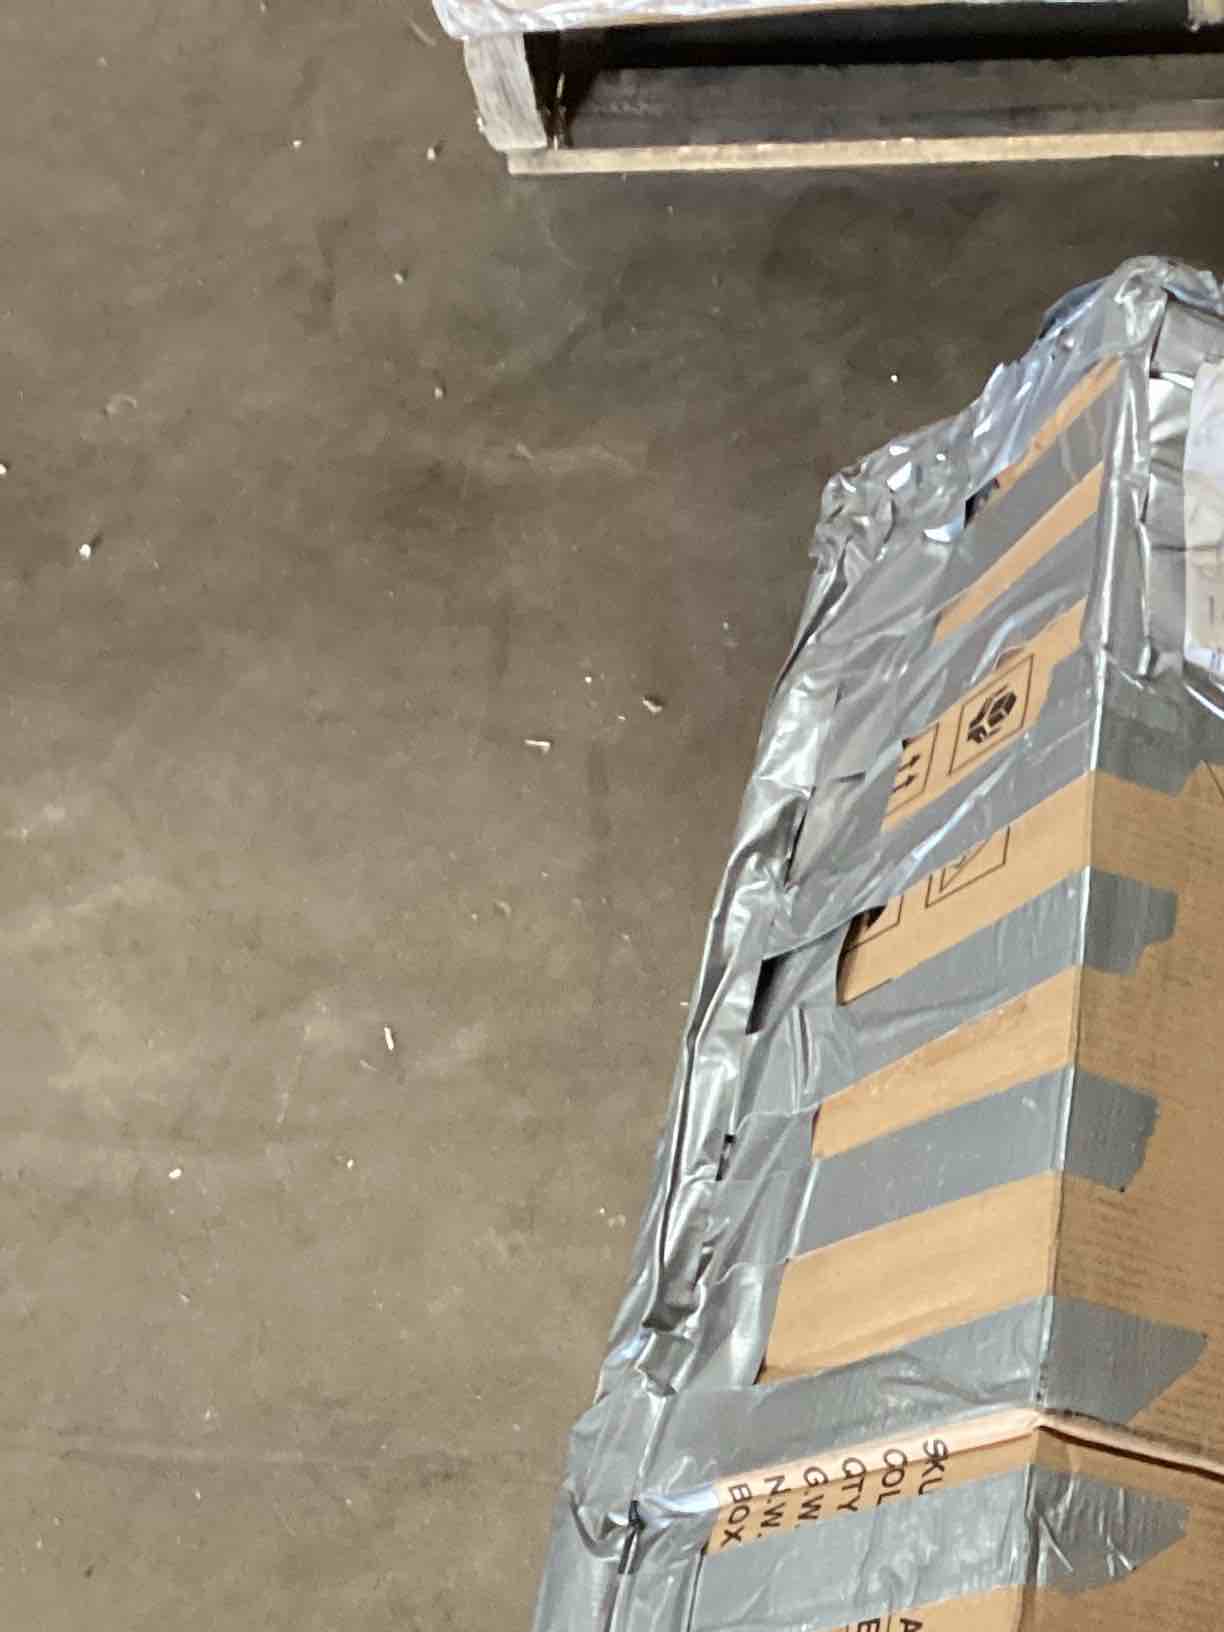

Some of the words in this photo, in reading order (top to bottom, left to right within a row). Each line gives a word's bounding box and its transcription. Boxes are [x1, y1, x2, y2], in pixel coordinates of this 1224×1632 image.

[720, 1483, 753, 1547] BOX
[756, 1475, 792, 1538] N.W.
[835, 1457, 867, 1513] QTY
